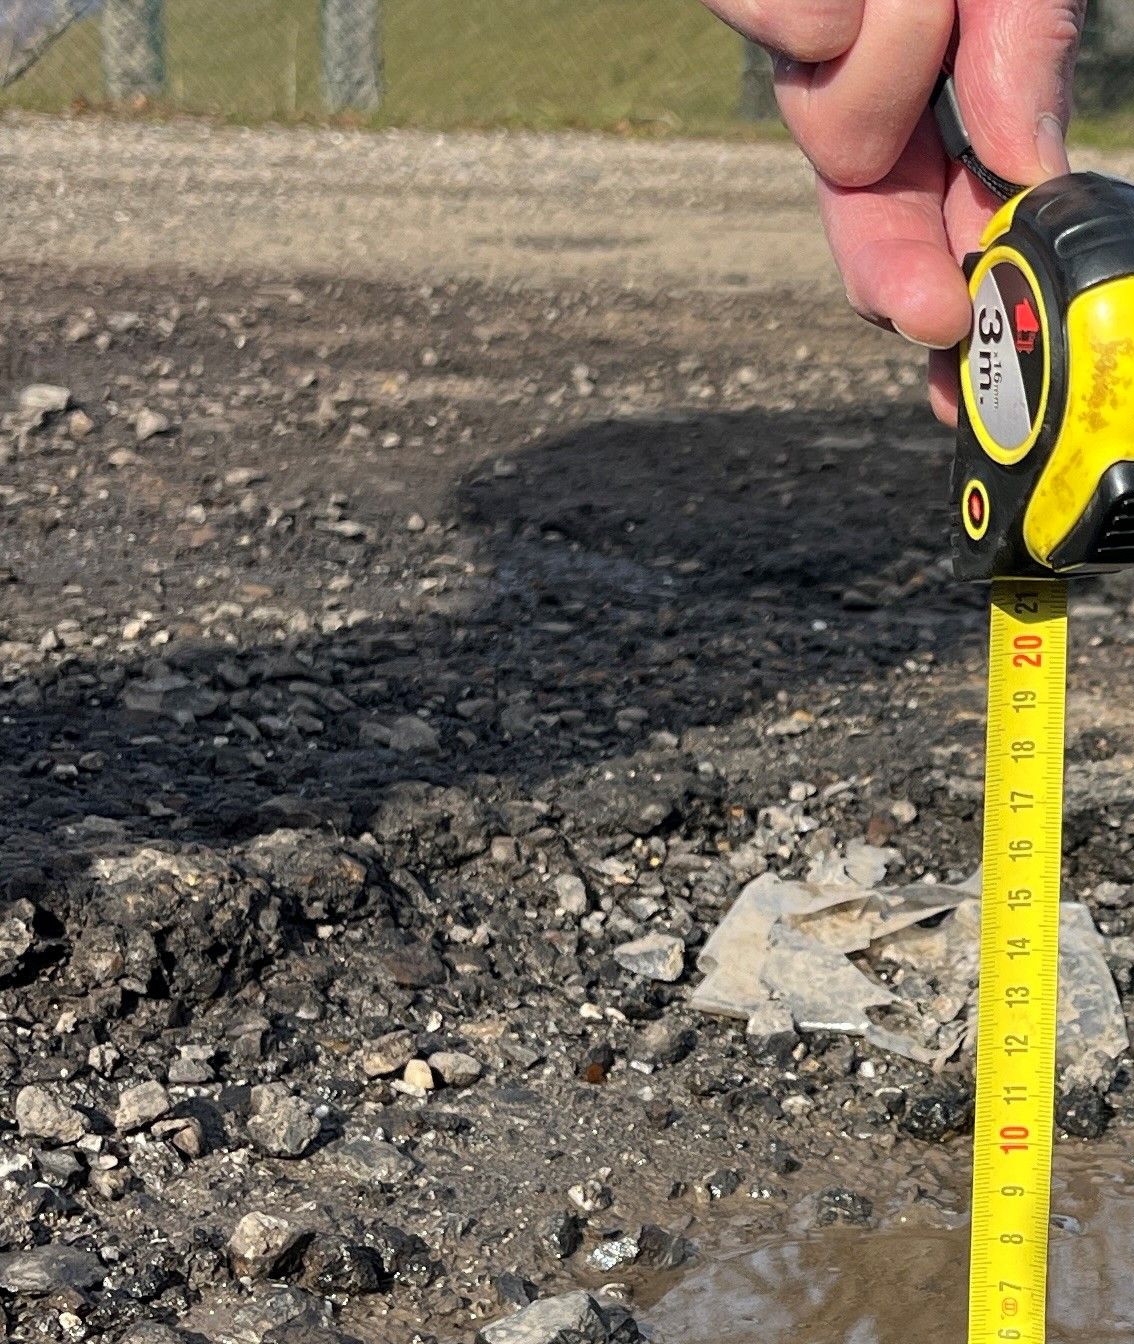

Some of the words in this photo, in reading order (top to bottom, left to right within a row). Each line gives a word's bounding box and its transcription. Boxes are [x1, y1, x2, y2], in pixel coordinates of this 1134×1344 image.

[1014, 591, 1039, 615] 21
[1012, 635, 1043, 668] 20
[1012, 690, 1036, 713] 19
[1011, 740, 1035, 764] 18
[1009, 791, 1034, 814] 17
[1008, 839, 1033, 862] 16
[1007, 889, 1032, 912] 15
[1006, 937, 1031, 961] 14
[1005, 986, 1030, 1009] 13
[1004, 1034, 1029, 1057] 12
[1003, 1085, 1028, 1105] 11
[999, 1126, 1029, 1155] 10
[1000, 1185, 1025, 1197] 9
[999, 1233, 1024, 1245] 8
[998, 1280, 1022, 1292] 7
[997, 1328, 1021, 1340] 6
